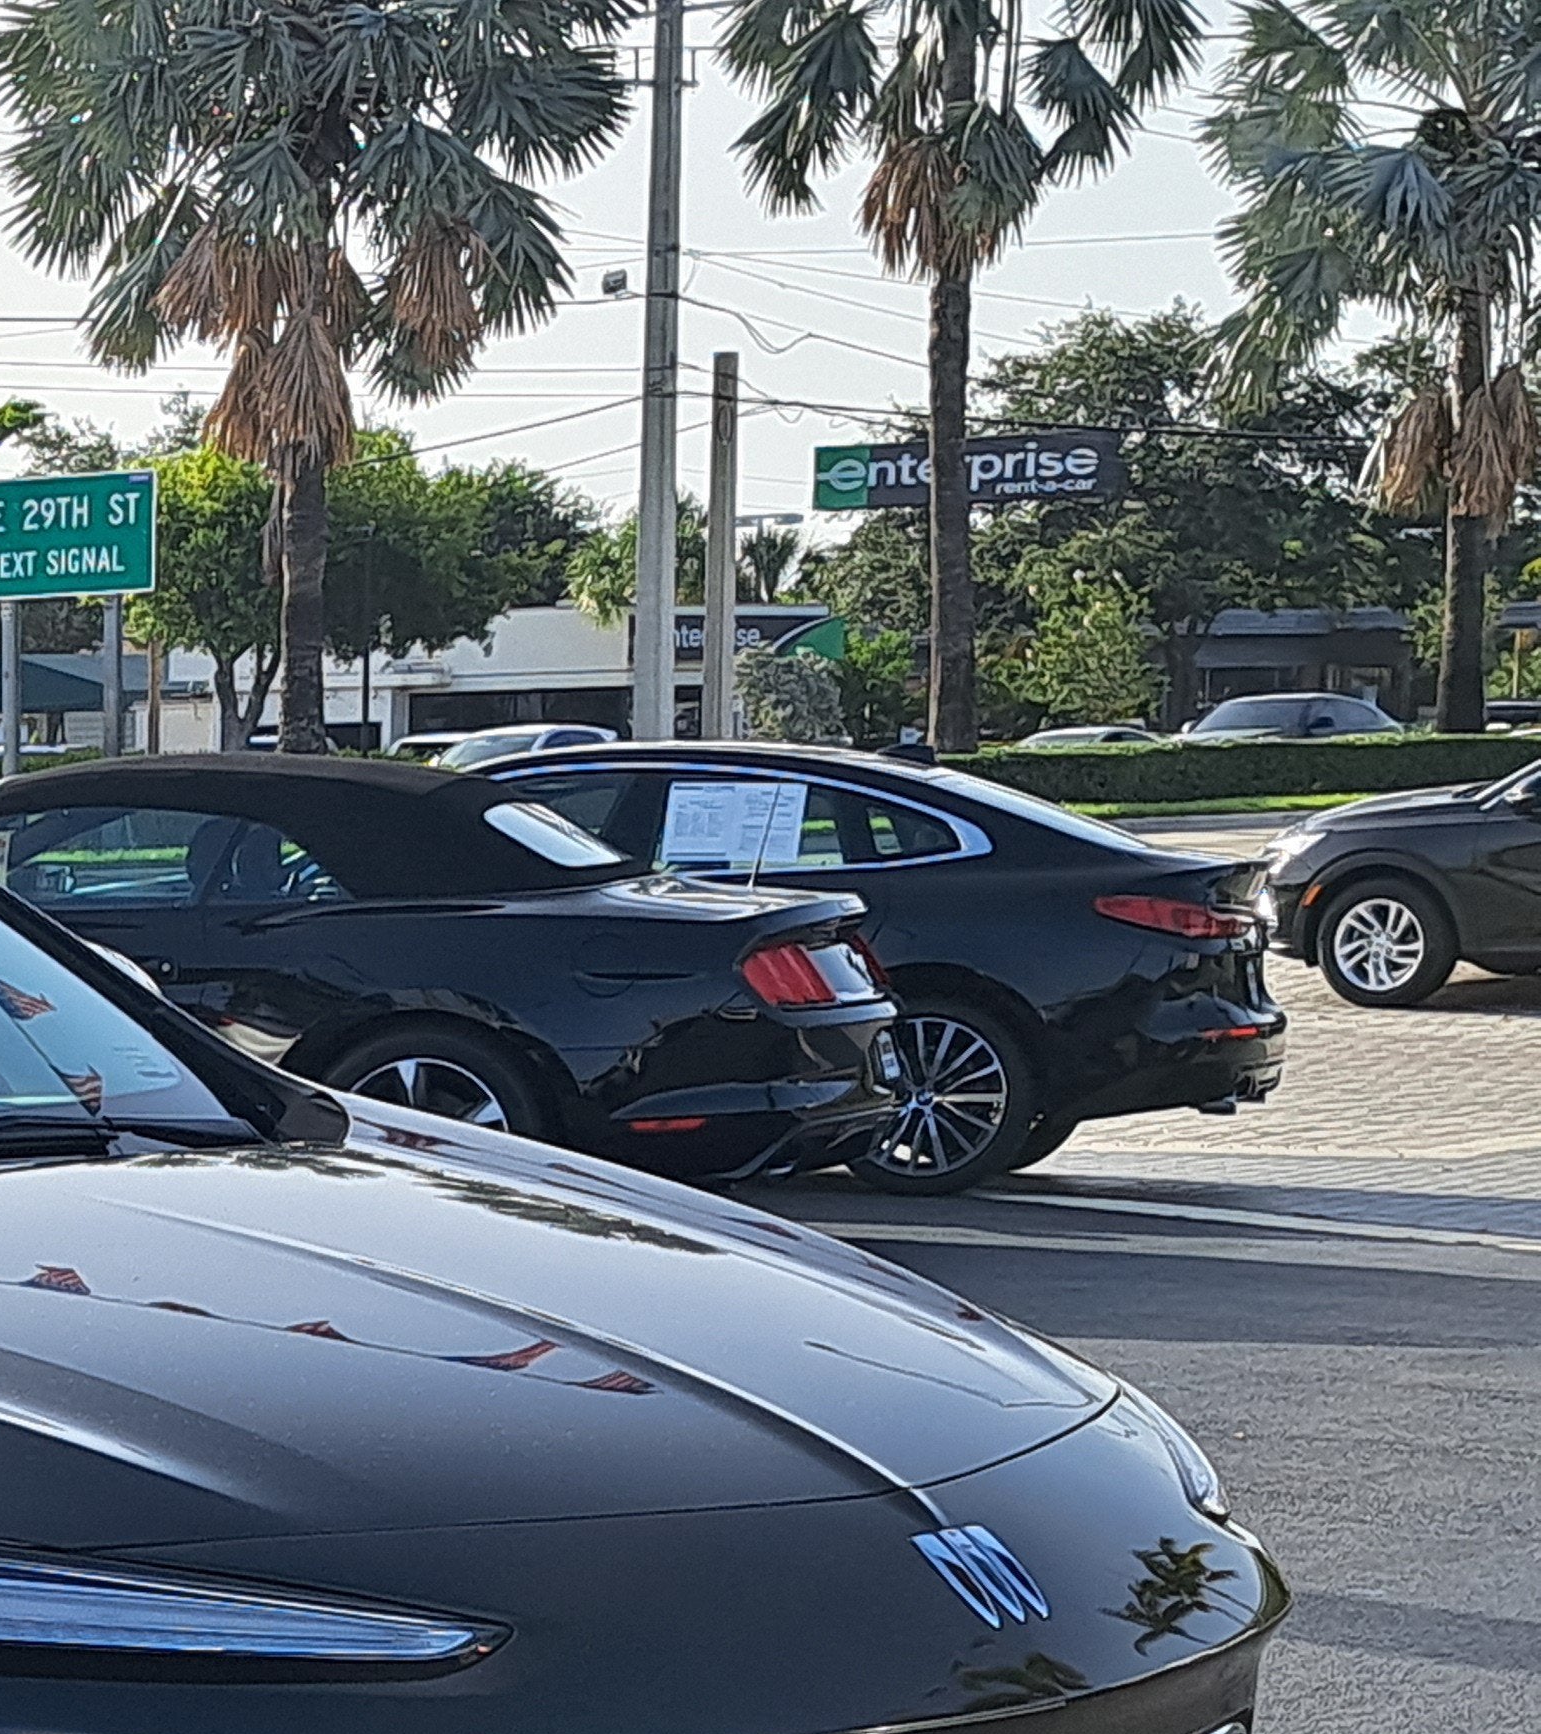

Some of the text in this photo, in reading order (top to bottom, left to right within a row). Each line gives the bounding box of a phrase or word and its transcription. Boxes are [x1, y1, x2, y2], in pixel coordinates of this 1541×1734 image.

[817, 442, 1099, 492] enteprise
[21, 494, 90, 532] 29TH
[107, 491, 142, 527] ST
[45, 545, 126, 576] SIGNAL
